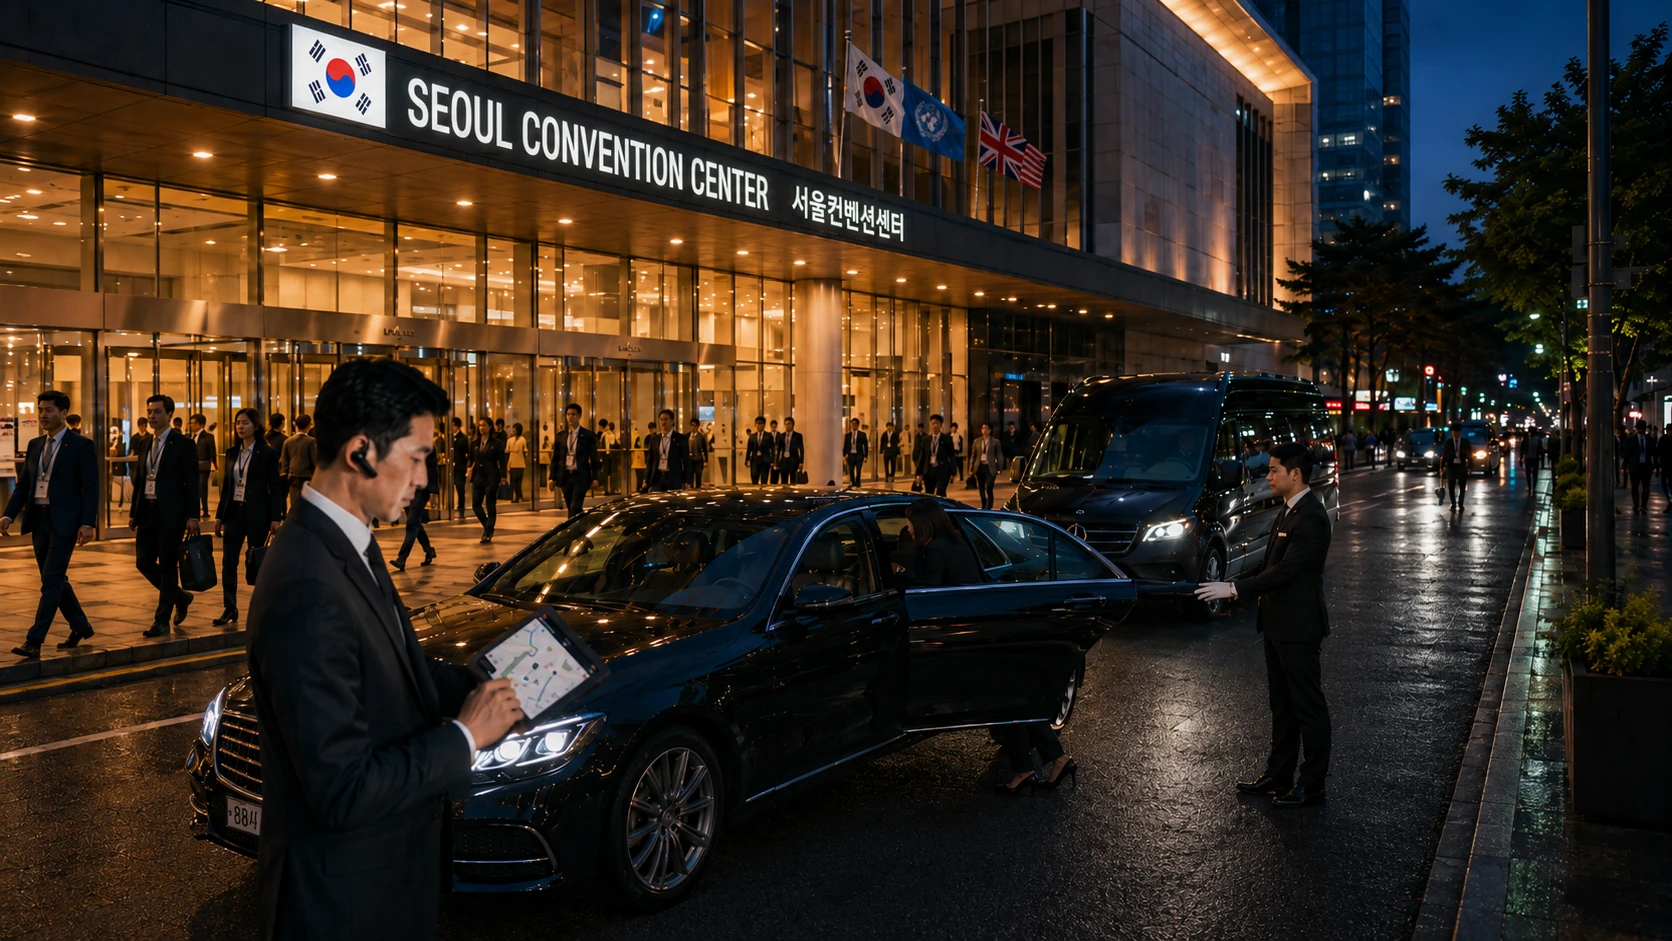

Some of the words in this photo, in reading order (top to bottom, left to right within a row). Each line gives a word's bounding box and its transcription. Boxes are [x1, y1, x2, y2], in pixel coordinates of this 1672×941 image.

[407, 77, 513, 150] SEOUL
[522, 110, 684, 191] CONVENTION
[690, 157, 770, 211] CENTER
[791, 185, 905, 242] 서울컨벤션센터
